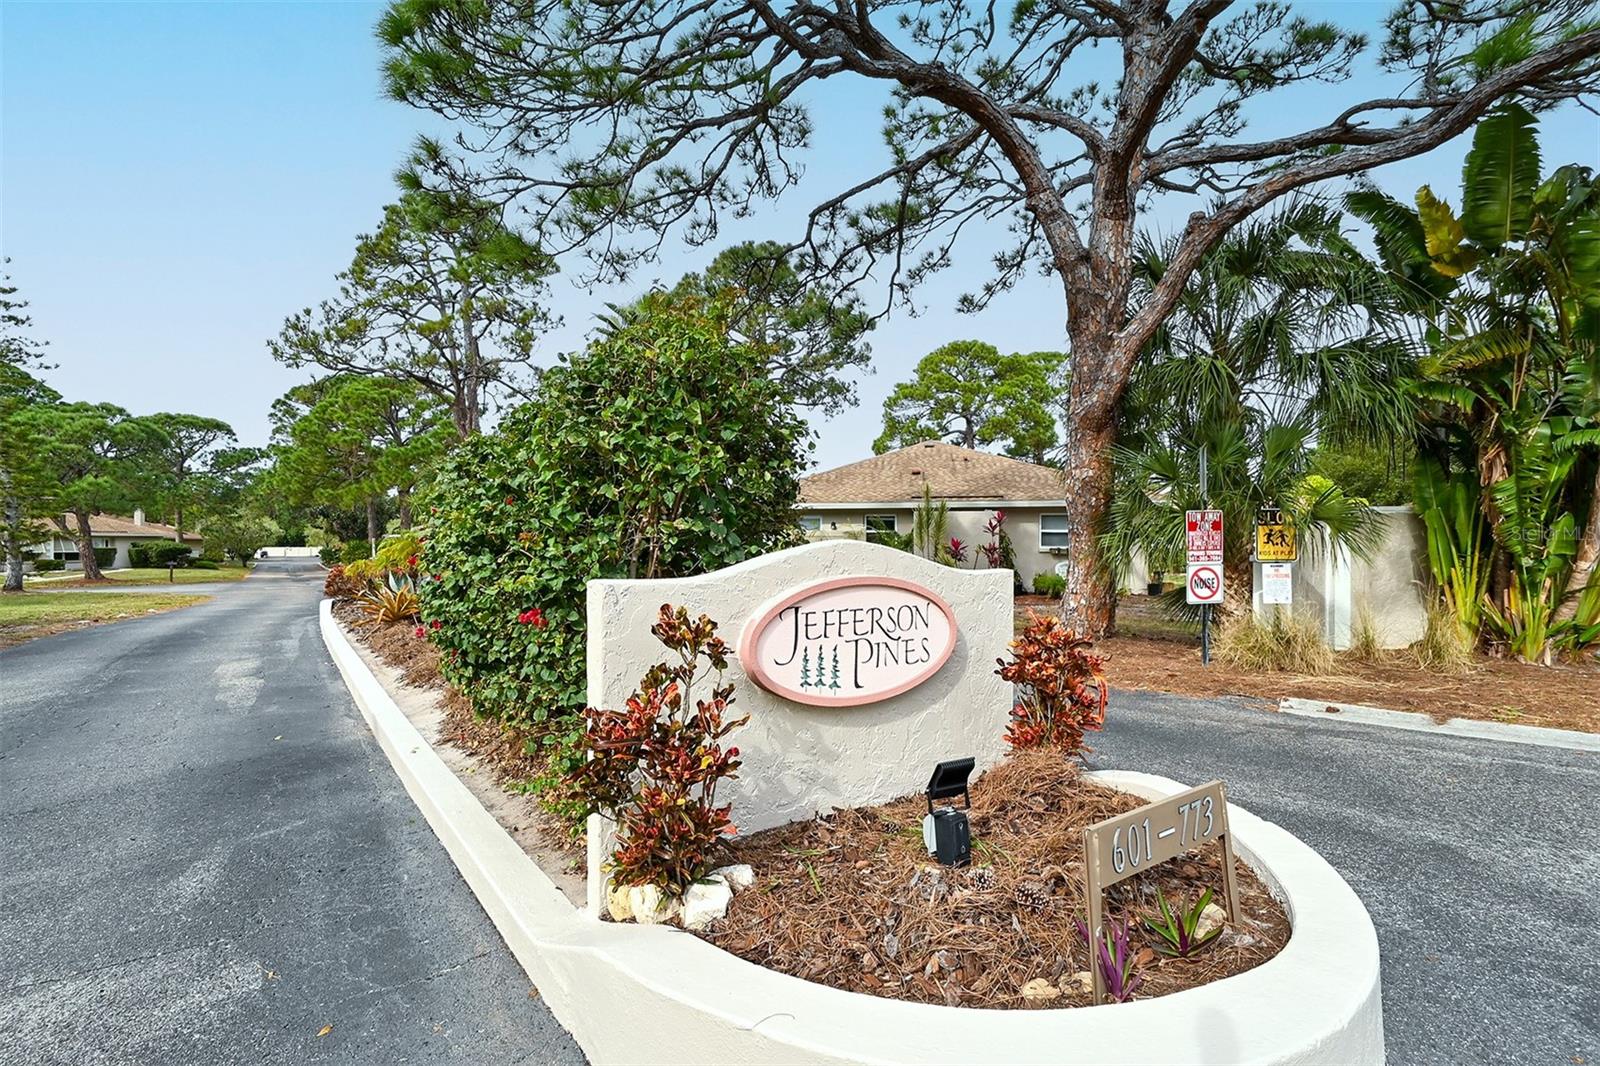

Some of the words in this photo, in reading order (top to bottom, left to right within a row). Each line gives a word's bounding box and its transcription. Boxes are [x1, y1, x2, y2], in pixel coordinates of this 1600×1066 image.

[1188, 512, 1201, 522] TOW
[1204, 512, 1221, 522] AWAY
[1196, 520, 1214, 531] ZONE
[1193, 577, 1216, 590] NOISE
[774, 602, 930, 666] JEFFERSON
[845, 637, 931, 689] PINES
